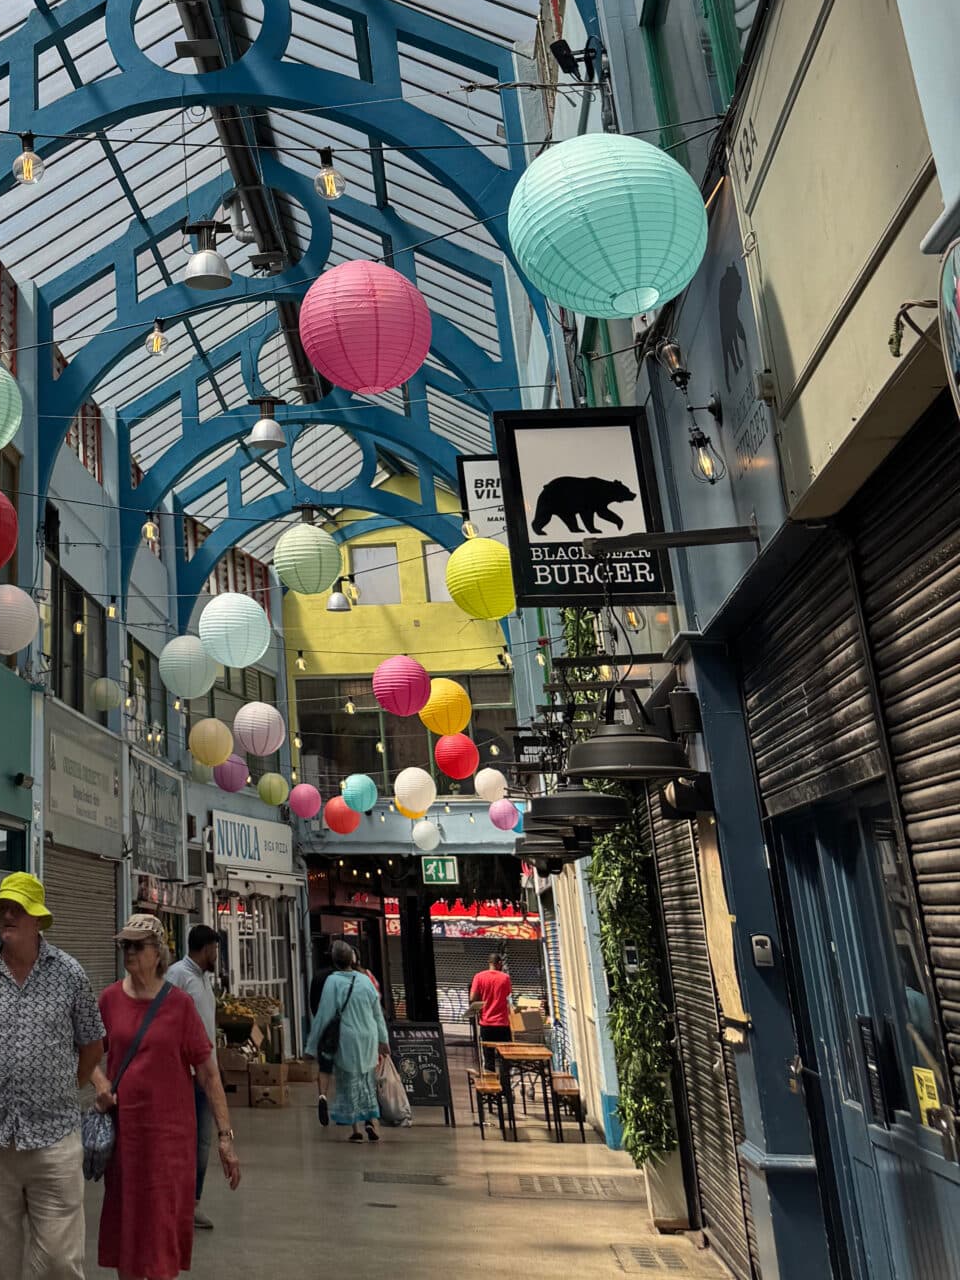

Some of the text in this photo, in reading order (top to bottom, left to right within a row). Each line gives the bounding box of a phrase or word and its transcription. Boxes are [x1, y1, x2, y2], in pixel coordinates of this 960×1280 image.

[740, 116, 758, 184] 13A
[530, 546, 594, 561] BLACK
[532, 561, 655, 585] BURGER
[217, 818, 261, 861] NUVOLA
